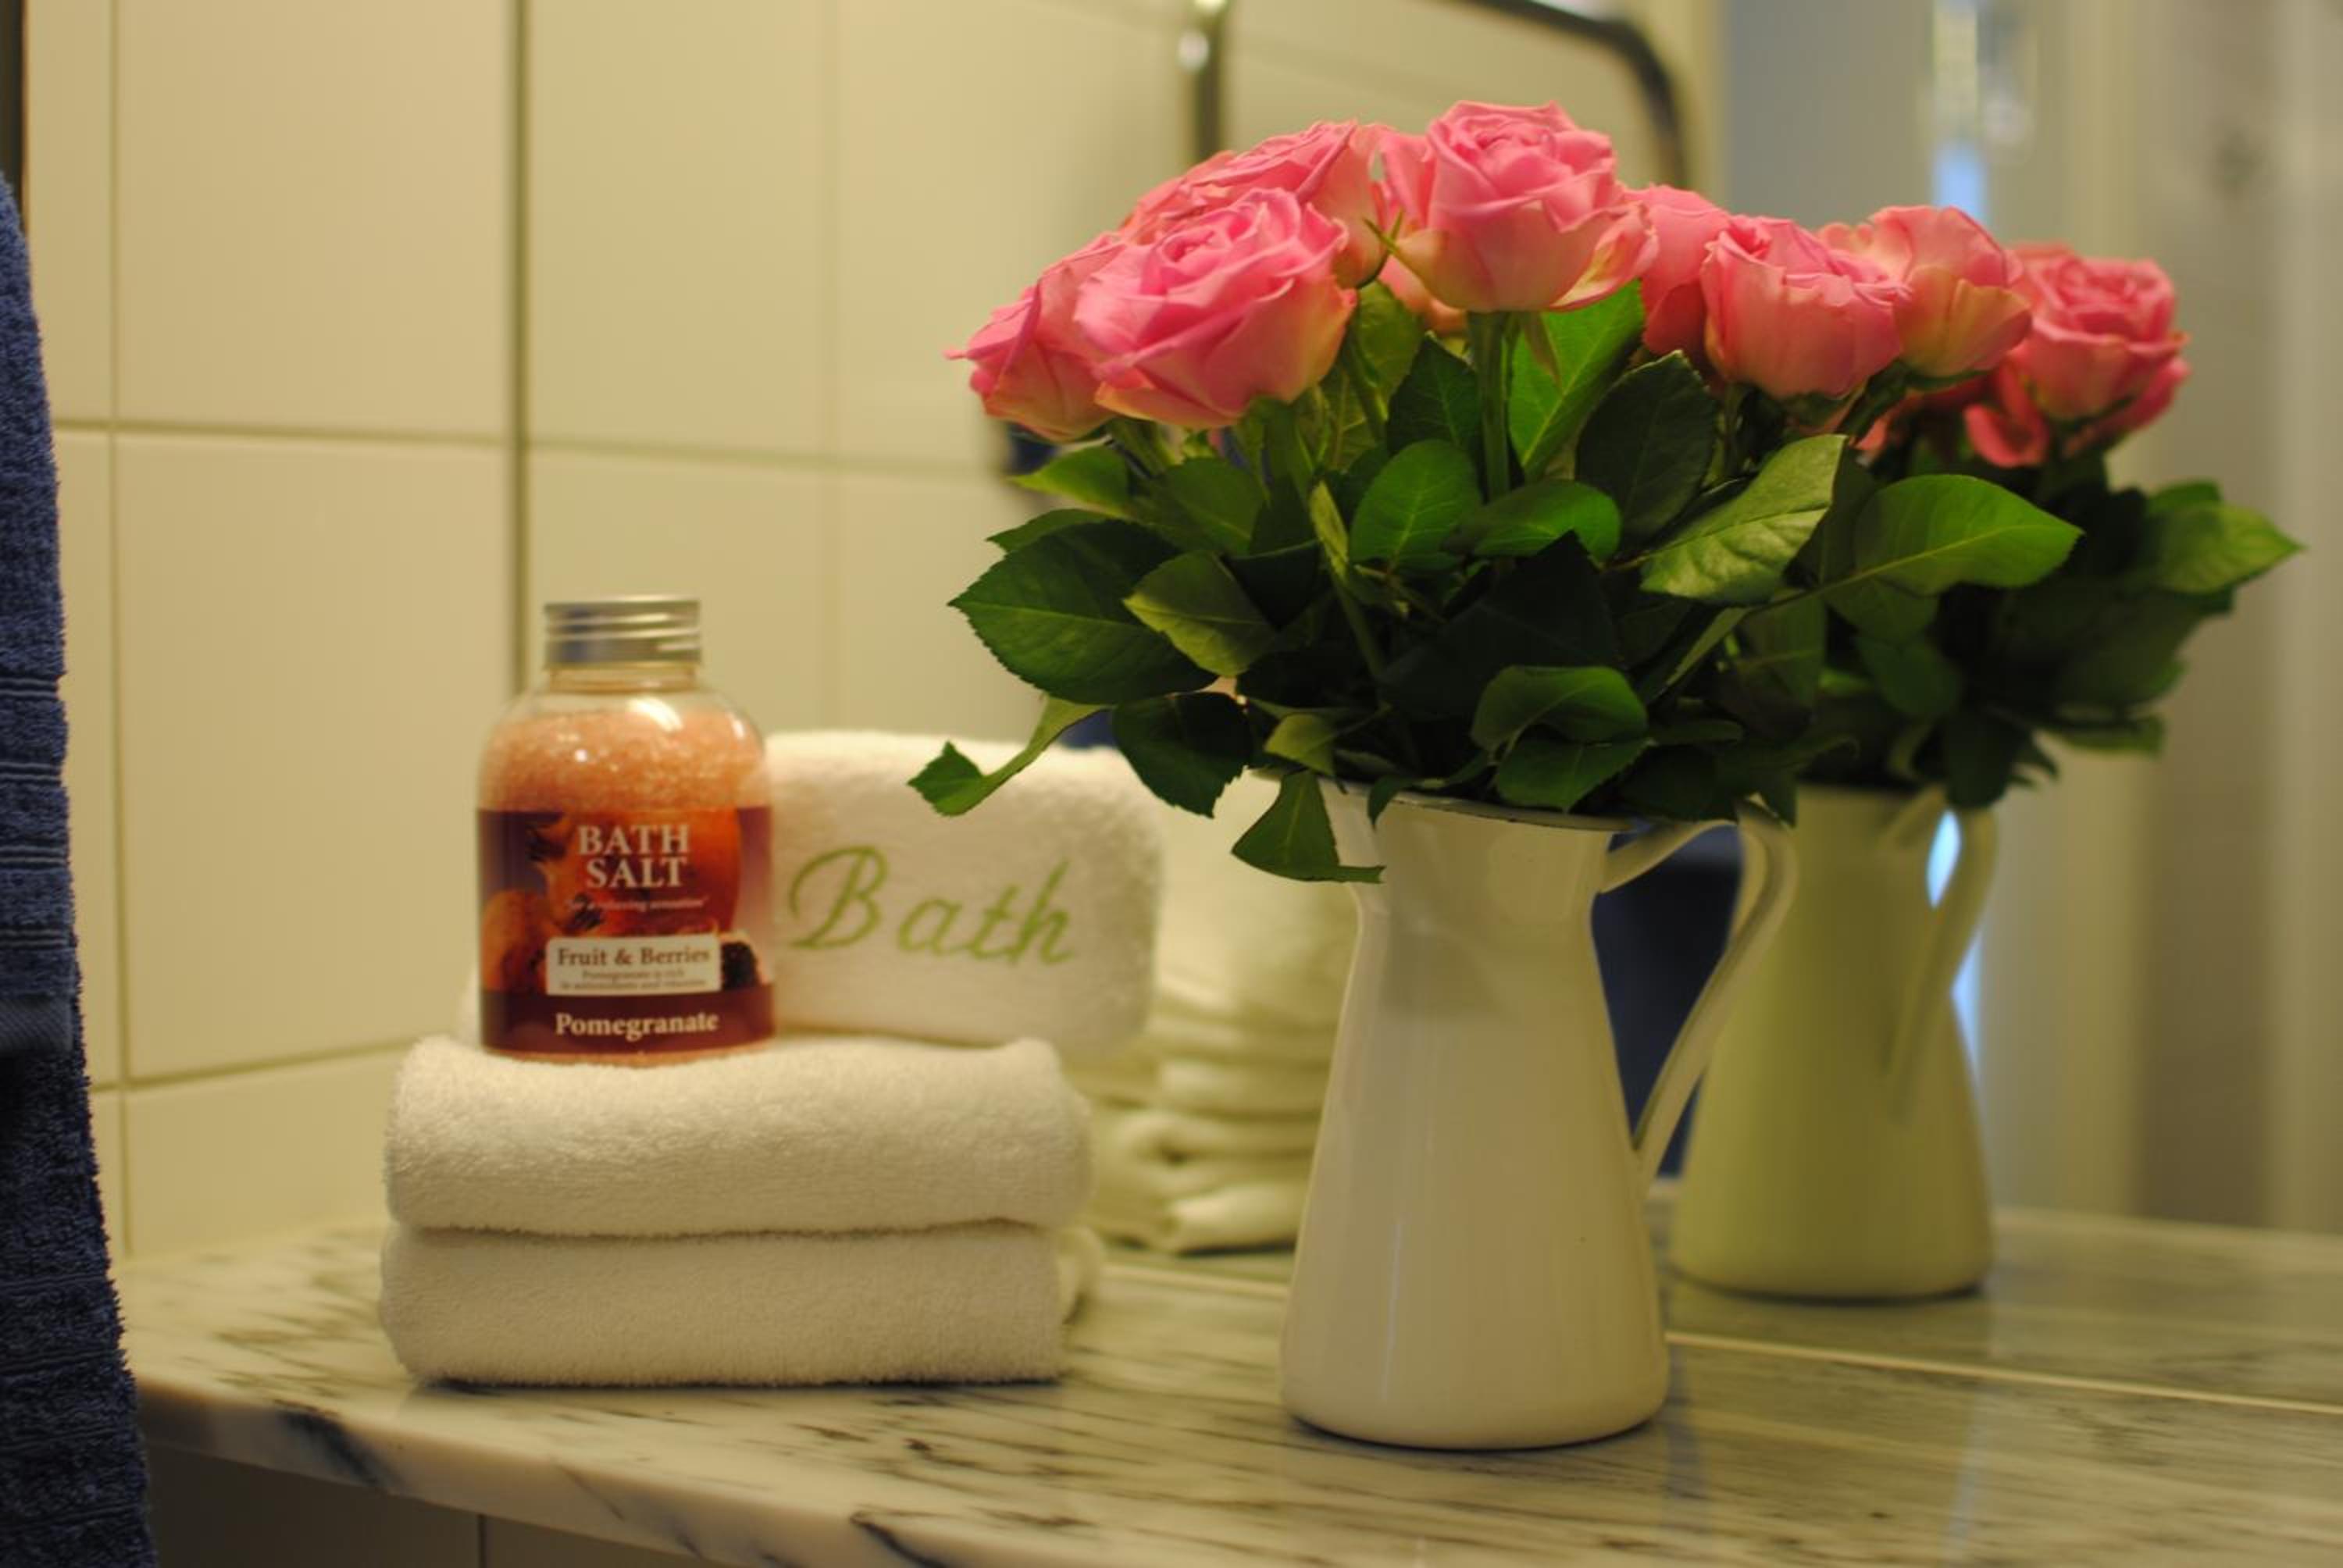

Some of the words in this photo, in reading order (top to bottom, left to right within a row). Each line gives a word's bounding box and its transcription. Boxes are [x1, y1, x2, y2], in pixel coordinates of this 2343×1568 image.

[577, 824, 690, 856] BATH
[586, 856, 687, 889] SALT
[787, 844, 1075, 966] Bath
[557, 946, 608, 967] Fruit
[614, 947, 633, 966] &
[640, 945, 711, 966] Berries
[555, 1012, 719, 1041] Pomegranate
